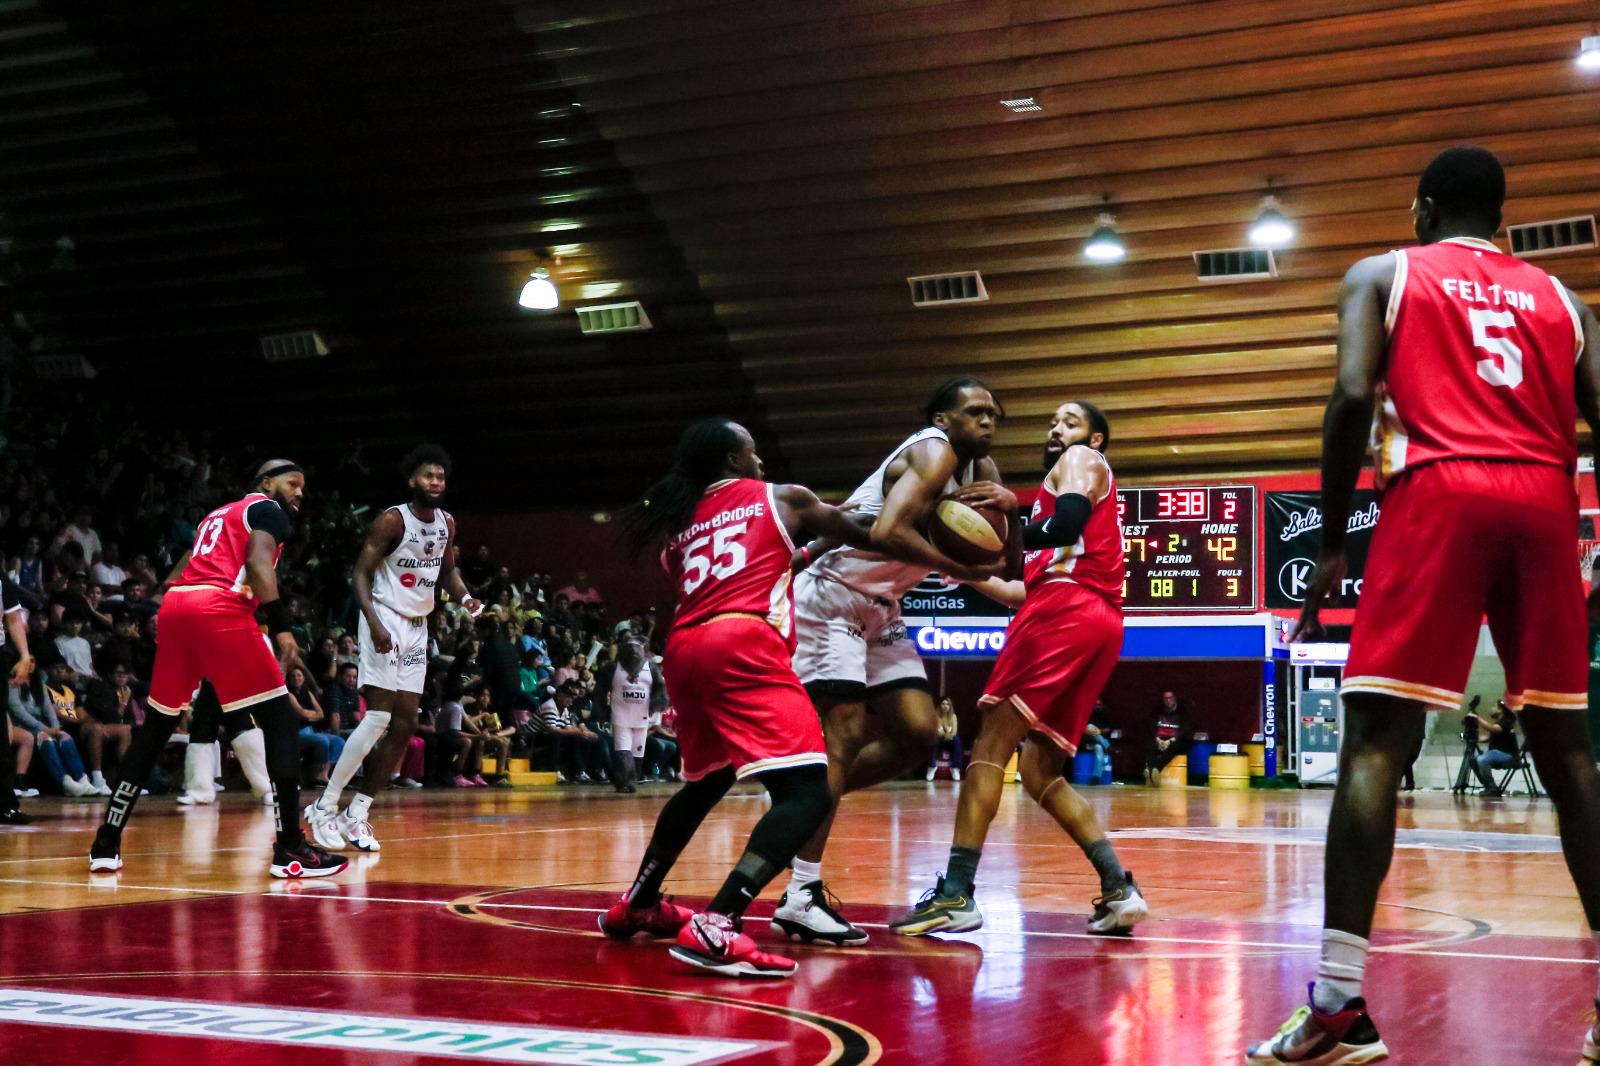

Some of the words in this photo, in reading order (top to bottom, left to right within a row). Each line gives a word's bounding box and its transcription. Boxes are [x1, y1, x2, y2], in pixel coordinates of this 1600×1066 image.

[1442, 279, 1535, 311] FELTON
[1468, 307, 1523, 389] 5
[1158, 492, 1205, 516] 3:38
[1222, 492, 1238, 500] TOL
[1224, 501, 1236, 520] 2
[1123, 525, 1149, 536] EST
[1200, 523, 1239, 535] HOME
[1280, 507, 1322, 541] Sals
[192, 517, 223, 558] 13
[1168, 533, 1180, 552] 2
[682, 521, 748, 595] 55
[1207, 536, 1237, 561] 42
[1155, 554, 1193, 564] PERIOD
[1147, 569, 1201, 577] PLAYER-FOUL
[1217, 569, 1243, 577] FOULS
[1150, 579, 1173, 597] 08
[1226, 578, 1238, 597] 3
[903, 595, 966, 609] SoniGas
[917, 626, 1006, 650] Chevro
[1264, 683, 1275, 735] Chevron
